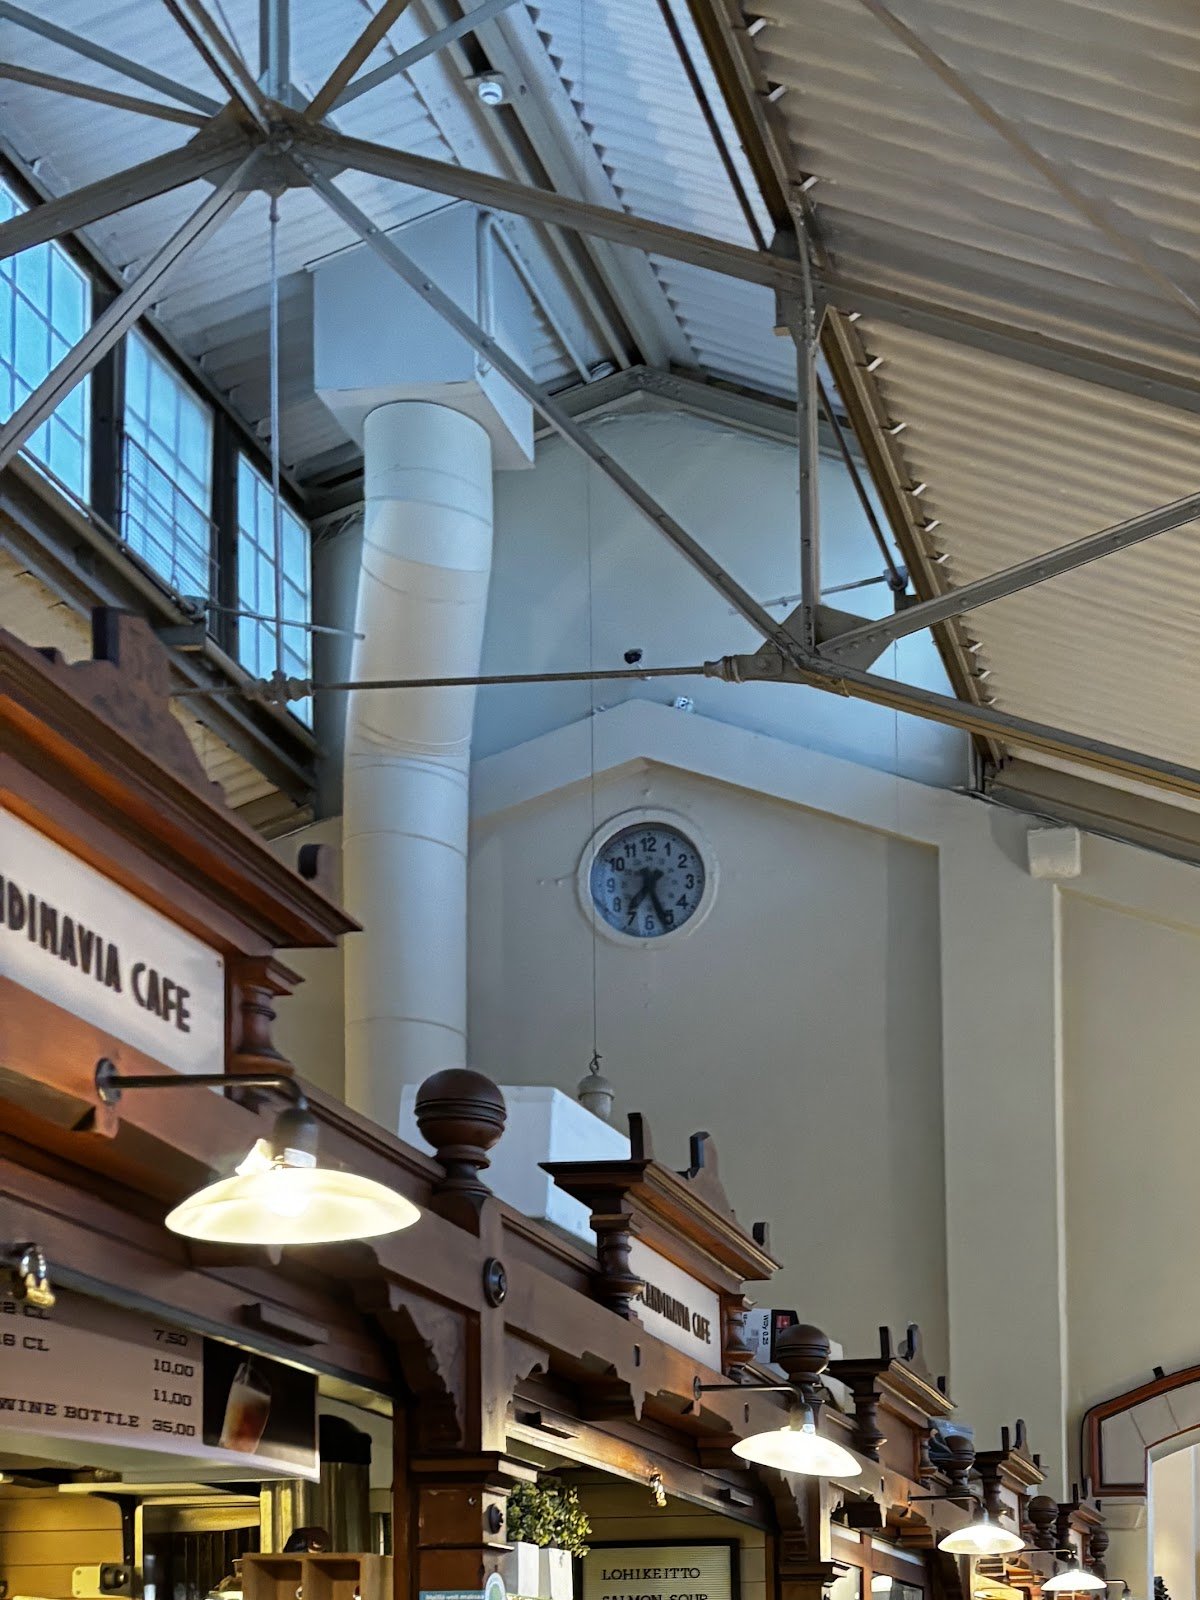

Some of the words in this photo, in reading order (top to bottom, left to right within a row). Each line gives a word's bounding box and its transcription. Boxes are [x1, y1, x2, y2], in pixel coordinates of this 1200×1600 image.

[624, 843, 636, 858] 11
[641, 837, 656, 852] 12
[664, 842, 671, 856] 1
[609, 857, 624, 871] 10
[678, 854, 687, 868] 2
[607, 878, 615, 893] 9
[686, 874, 694, 889] 3
[613, 897, 621, 912] 8
[676, 894, 689, 909] 4
[627, 911, 637, 925] 7
[645, 915, 654, 930] 6
[131, 962, 190, 1033] CAFE
[0, 1301, 16, 1315] 2
[692, 1312, 711, 1345] CAFE
[23, 1336, 50, 1351] CL
[64, 1405, 140, 1428] BOTTLE
